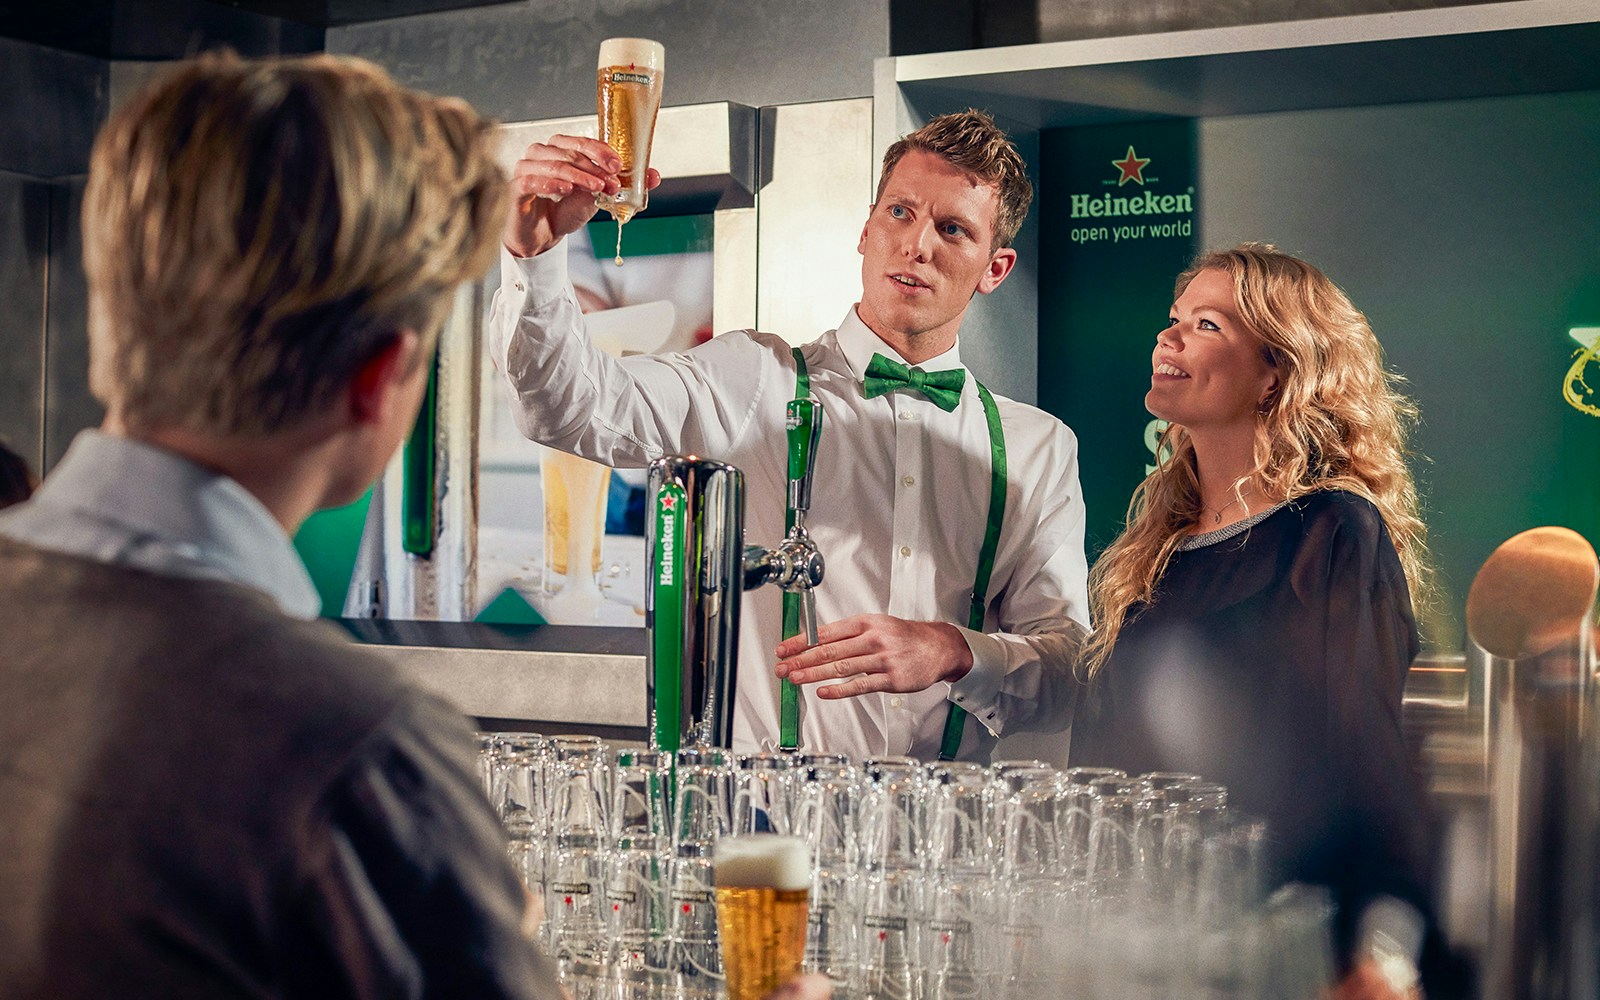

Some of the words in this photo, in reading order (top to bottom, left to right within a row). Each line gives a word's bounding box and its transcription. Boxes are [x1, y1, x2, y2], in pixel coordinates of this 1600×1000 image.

[613, 73, 650, 84] Heineken
[1071, 226, 1108, 244] open
[1113, 225, 1146, 243] your
[1150, 219, 1192, 238] world
[660, 514, 674, 586] Heineken
